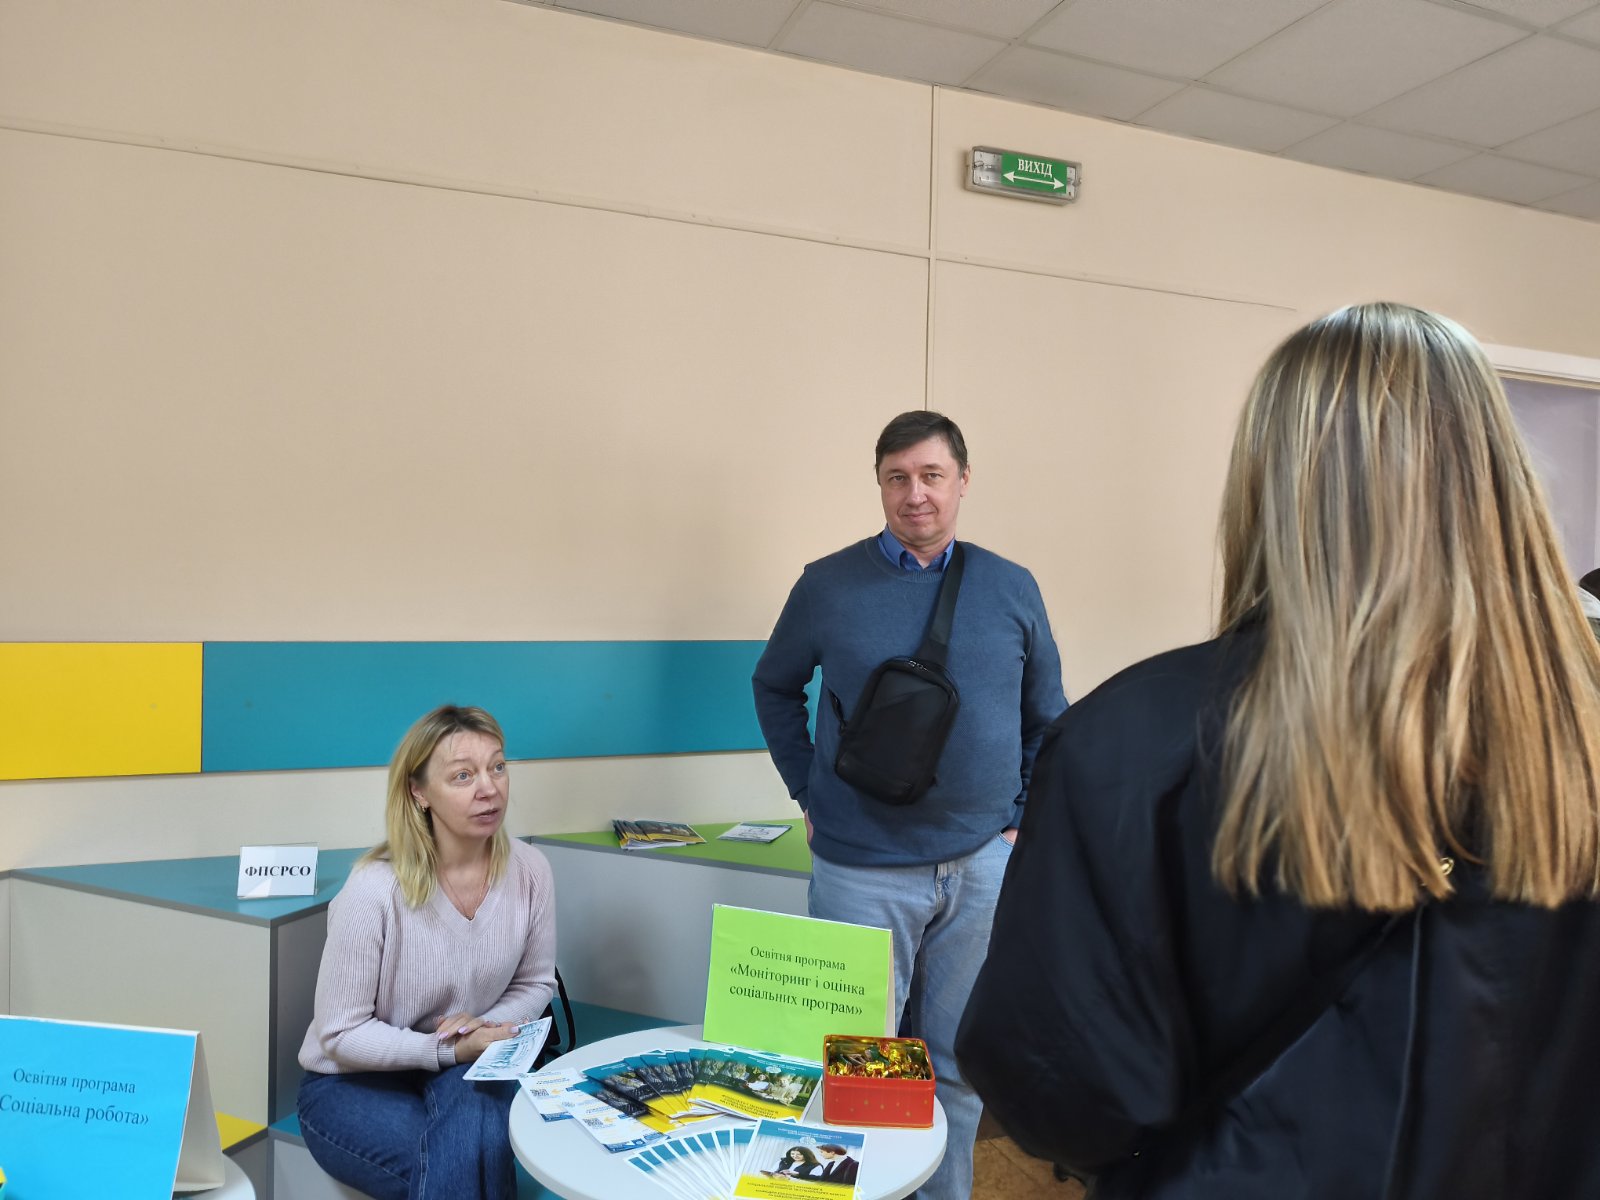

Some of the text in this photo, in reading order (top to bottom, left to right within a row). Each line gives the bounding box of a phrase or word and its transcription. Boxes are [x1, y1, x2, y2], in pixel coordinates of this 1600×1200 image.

[1017, 158, 1053, 178] ВИХІД
[245, 865, 311, 877] ФПСРСО
[750, 945, 846, 971] Освітня програма
[730, 963, 865, 996] «Моніторинг і оцінка
[729, 985, 863, 1016] соціальних програм»
[13, 1068, 136, 1095] Освітня програма
[85, 1105, 149, 1125] робота»
